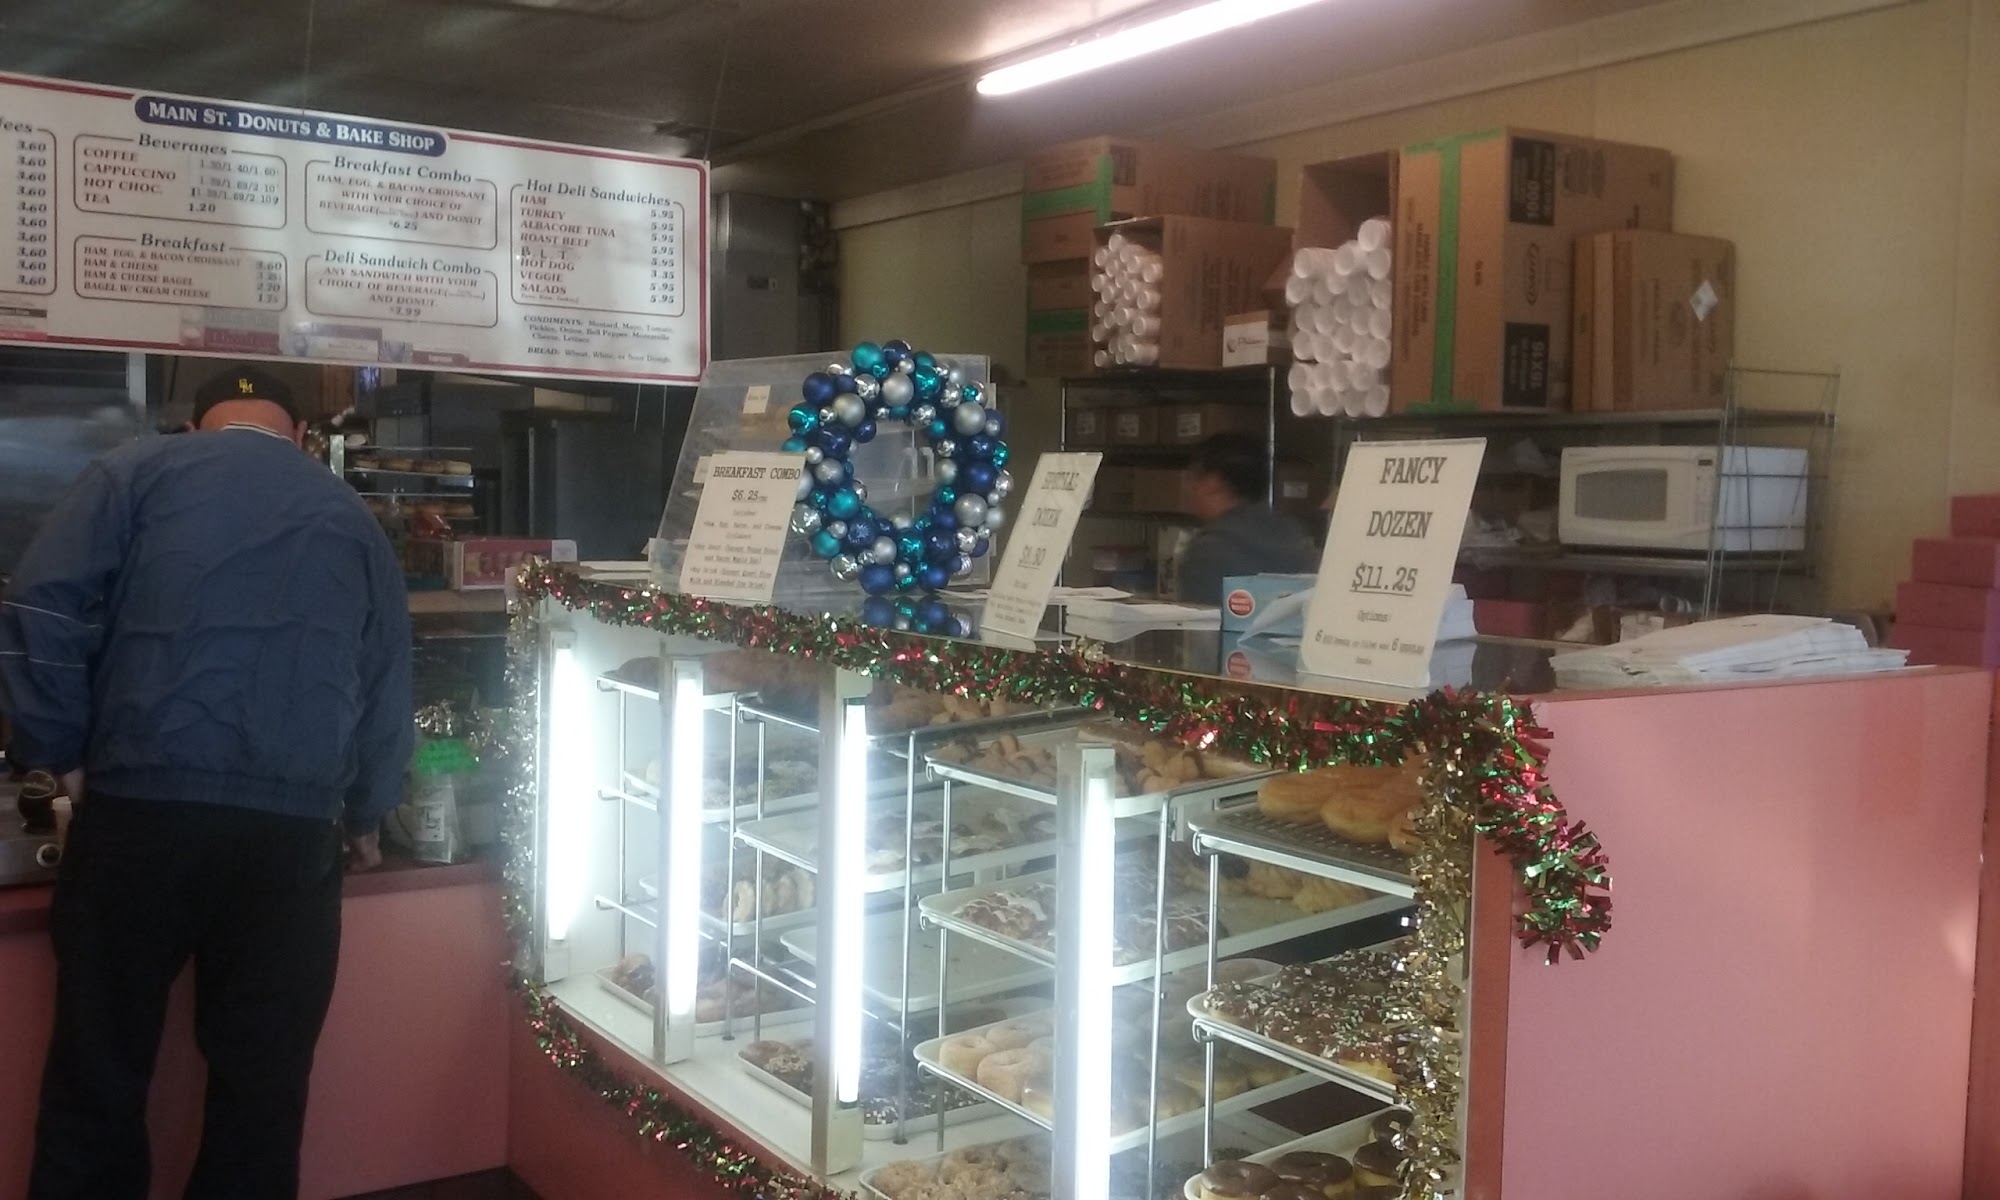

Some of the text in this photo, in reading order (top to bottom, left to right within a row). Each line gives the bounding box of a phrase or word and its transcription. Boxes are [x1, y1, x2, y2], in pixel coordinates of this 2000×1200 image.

[149, 101, 435, 151] MAIN ST. DONUTS & BAKE SHOP
[138, 133, 228, 155] Beverages
[83, 147, 139, 162] COFFEE
[83, 163, 176, 181] CAPPUCCINO
[334, 155, 472, 184] Breakfast Combo
[83, 177, 114, 190] HOT
[377, 180, 385, 189] &
[388, 182, 425, 194] BACON
[428, 187, 486, 202] CROISSANT
[342, 190, 463, 211] WITH YOUR CHOICE OF
[520, 195, 547, 205] HAM
[527, 178, 671, 207] Hot Deli Sandwiches
[84, 193, 216, 213] TEA 1.20
[420, 210, 444, 221] AND
[446, 213, 483, 225] DONUT
[520, 207, 566, 220] TURKEY
[520, 219, 582, 235] ALBACORE
[586, 226, 616, 238] TUNA
[140, 232, 225, 253] Breakfast
[520, 233, 559, 245] ROAST
[562, 236, 592, 247] BEEF
[84, 257, 106, 268] HAM
[110, 260, 117, 268] &
[121, 261, 160, 271] CHEESE
[139, 251, 146, 259] &
[150, 251, 184, 263] BACON
[187, 254, 241, 267] CROISSANT
[325, 249, 482, 275] Deli Sandwich Combo
[520, 257, 545, 269] HOT
[549, 261, 575, 271] DOG
[84, 269, 106, 280] HAM
[110, 272, 117, 280] &
[121, 273, 158, 283] CHEESE
[163, 275, 194, 286] BAGEL
[318, 279, 362, 290] CHOICE
[367, 282, 381, 291] OF
[323, 266, 478, 288] ANY SANDWICH WITH YOUR
[520, 270, 564, 283] VEGGIE
[84, 282, 117, 292] BAGEL
[135, 286, 170, 296] CREAM
[172, 288, 211, 298] CHEESE
[521, 282, 567, 295] SALADS
[369, 294, 394, 303] AND
[527, 346, 561, 356] BREAD:
[713, 466, 801, 480] BREAKFAST COMBO
[1379, 456, 1447, 485] FANCY
[1366, 510, 1433, 538] DOZEN
[1352, 562, 1418, 593] $11.25
[1315, 629, 1323, 642] 6
[1391, 638, 1399, 651] 6
